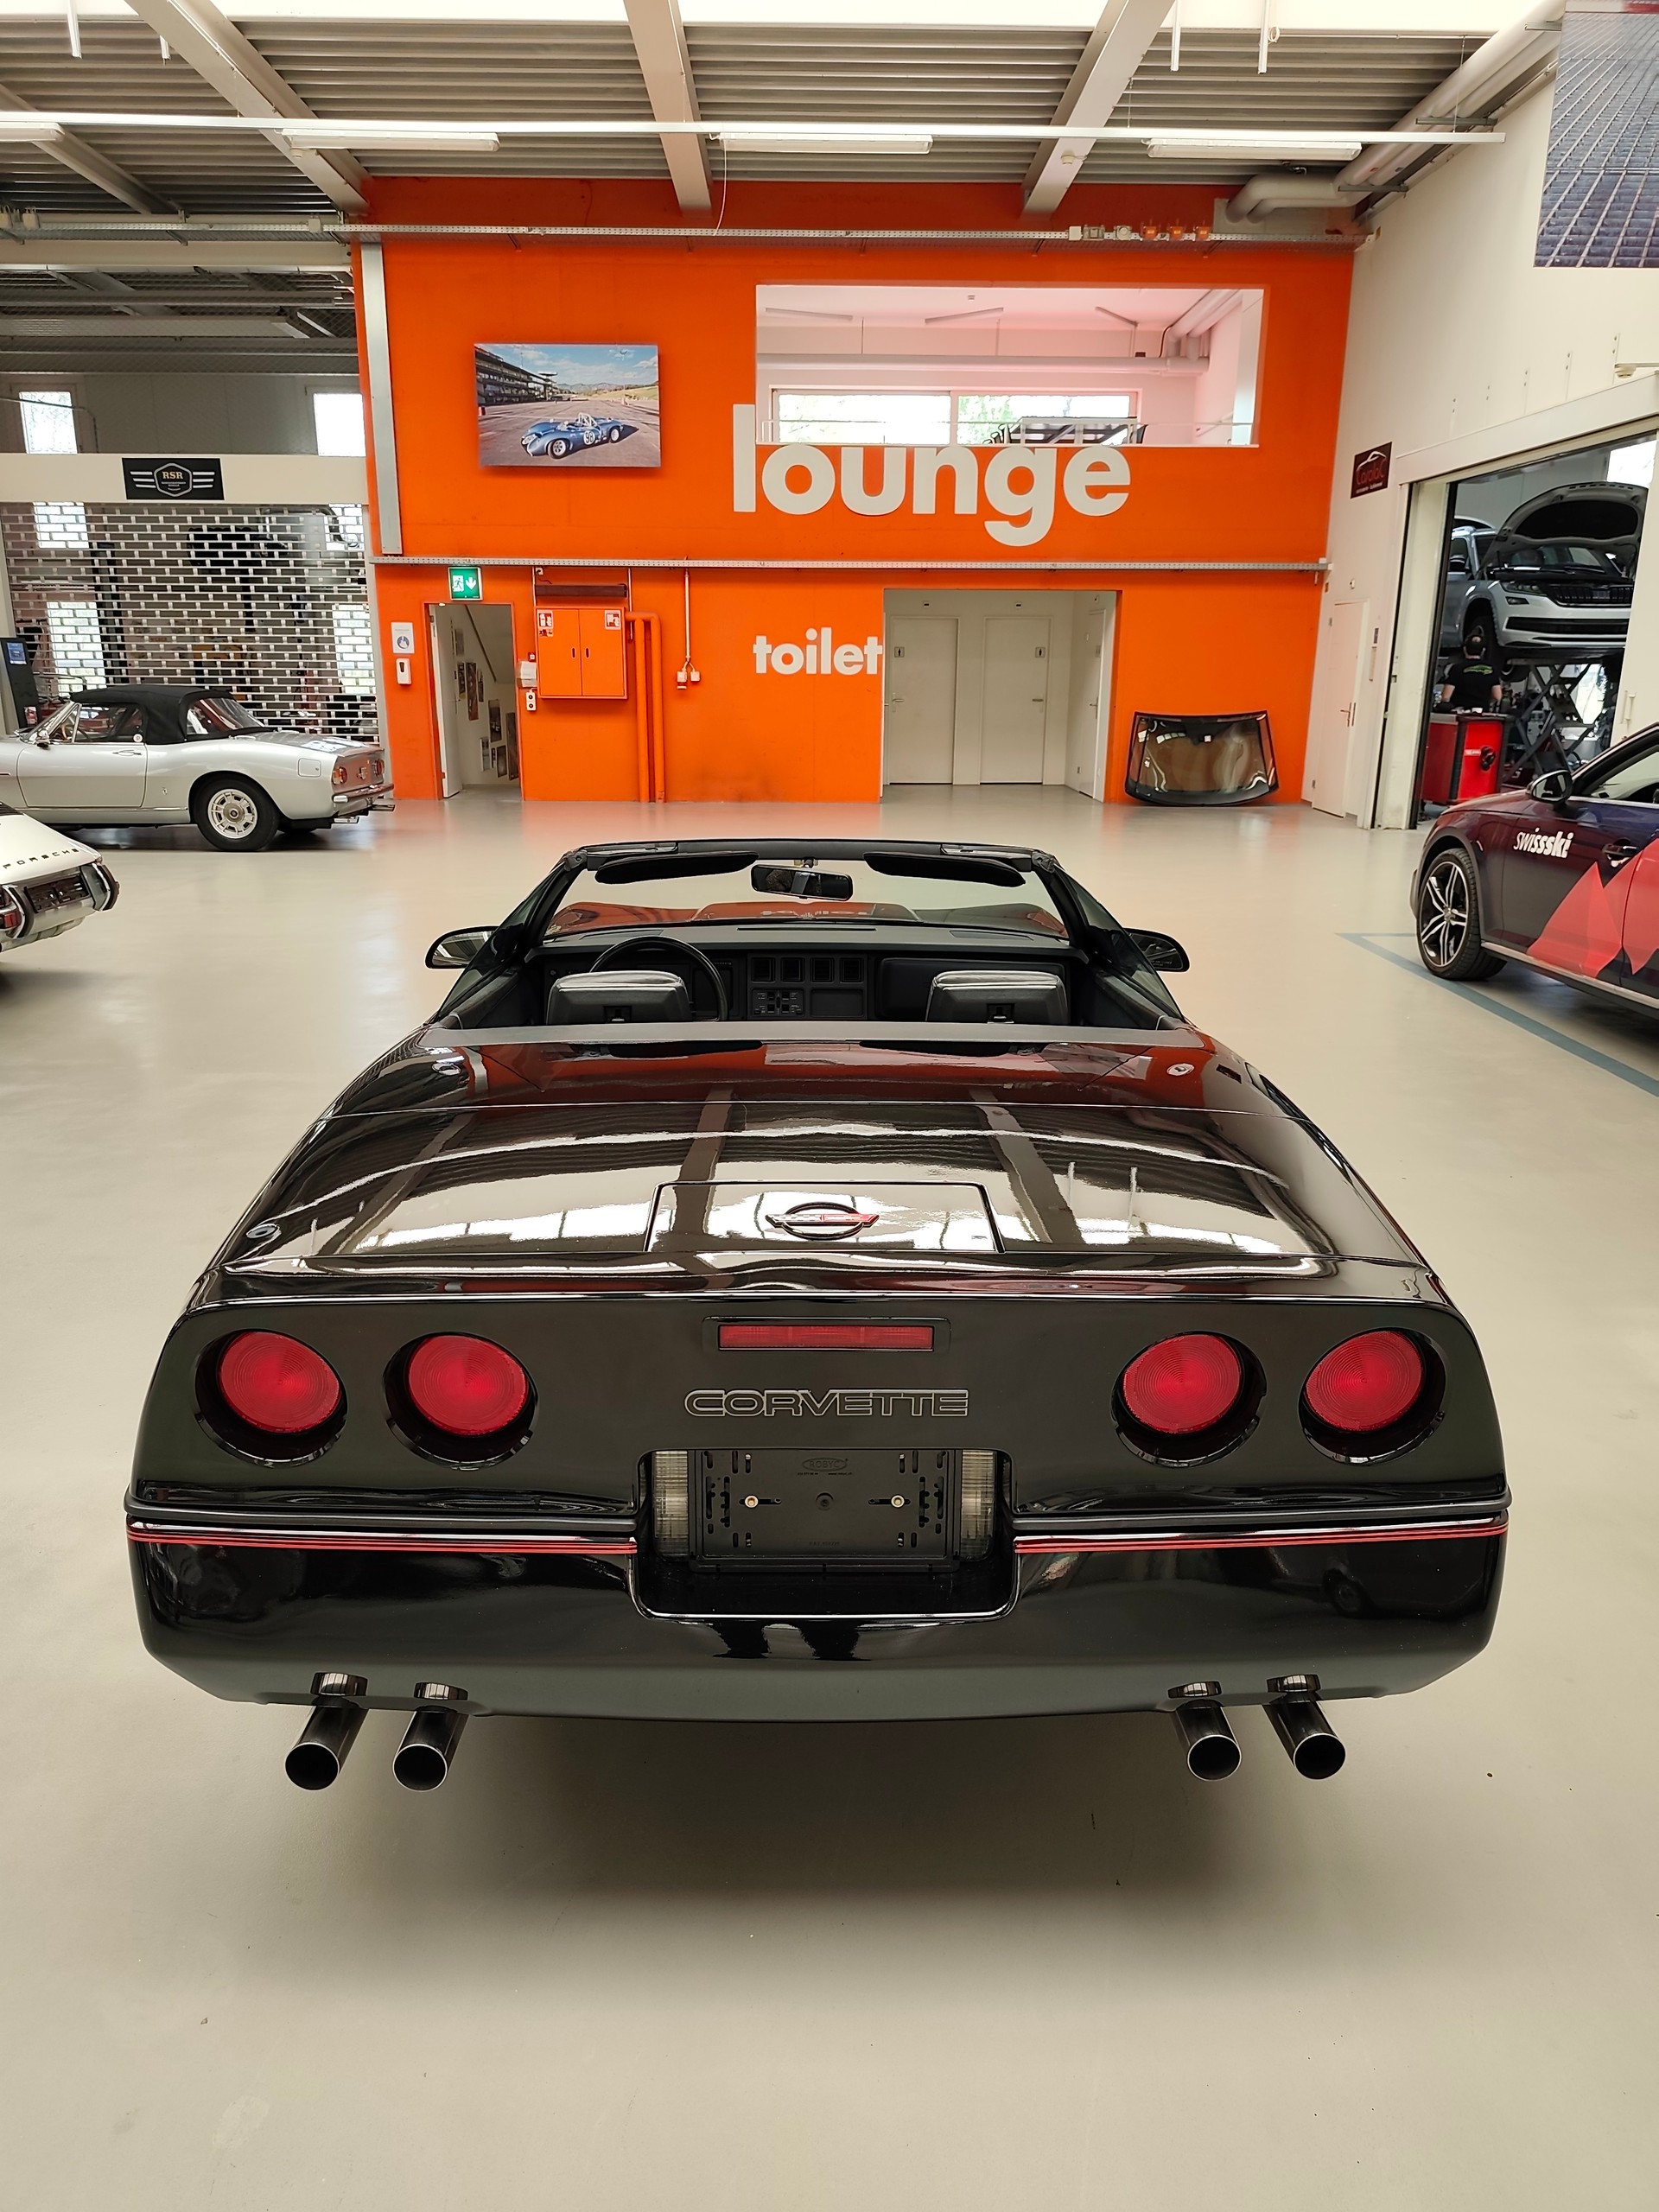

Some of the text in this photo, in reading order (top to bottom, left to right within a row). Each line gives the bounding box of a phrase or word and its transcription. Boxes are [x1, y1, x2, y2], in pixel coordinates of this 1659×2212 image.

[162, 471, 184, 480] RSR
[733, 404, 1131, 547] lounge
[753, 628, 883, 675] toilet
[3, 848, 79, 869] PORSCHE
[684, 1388, 969, 1417] CORVETTE
